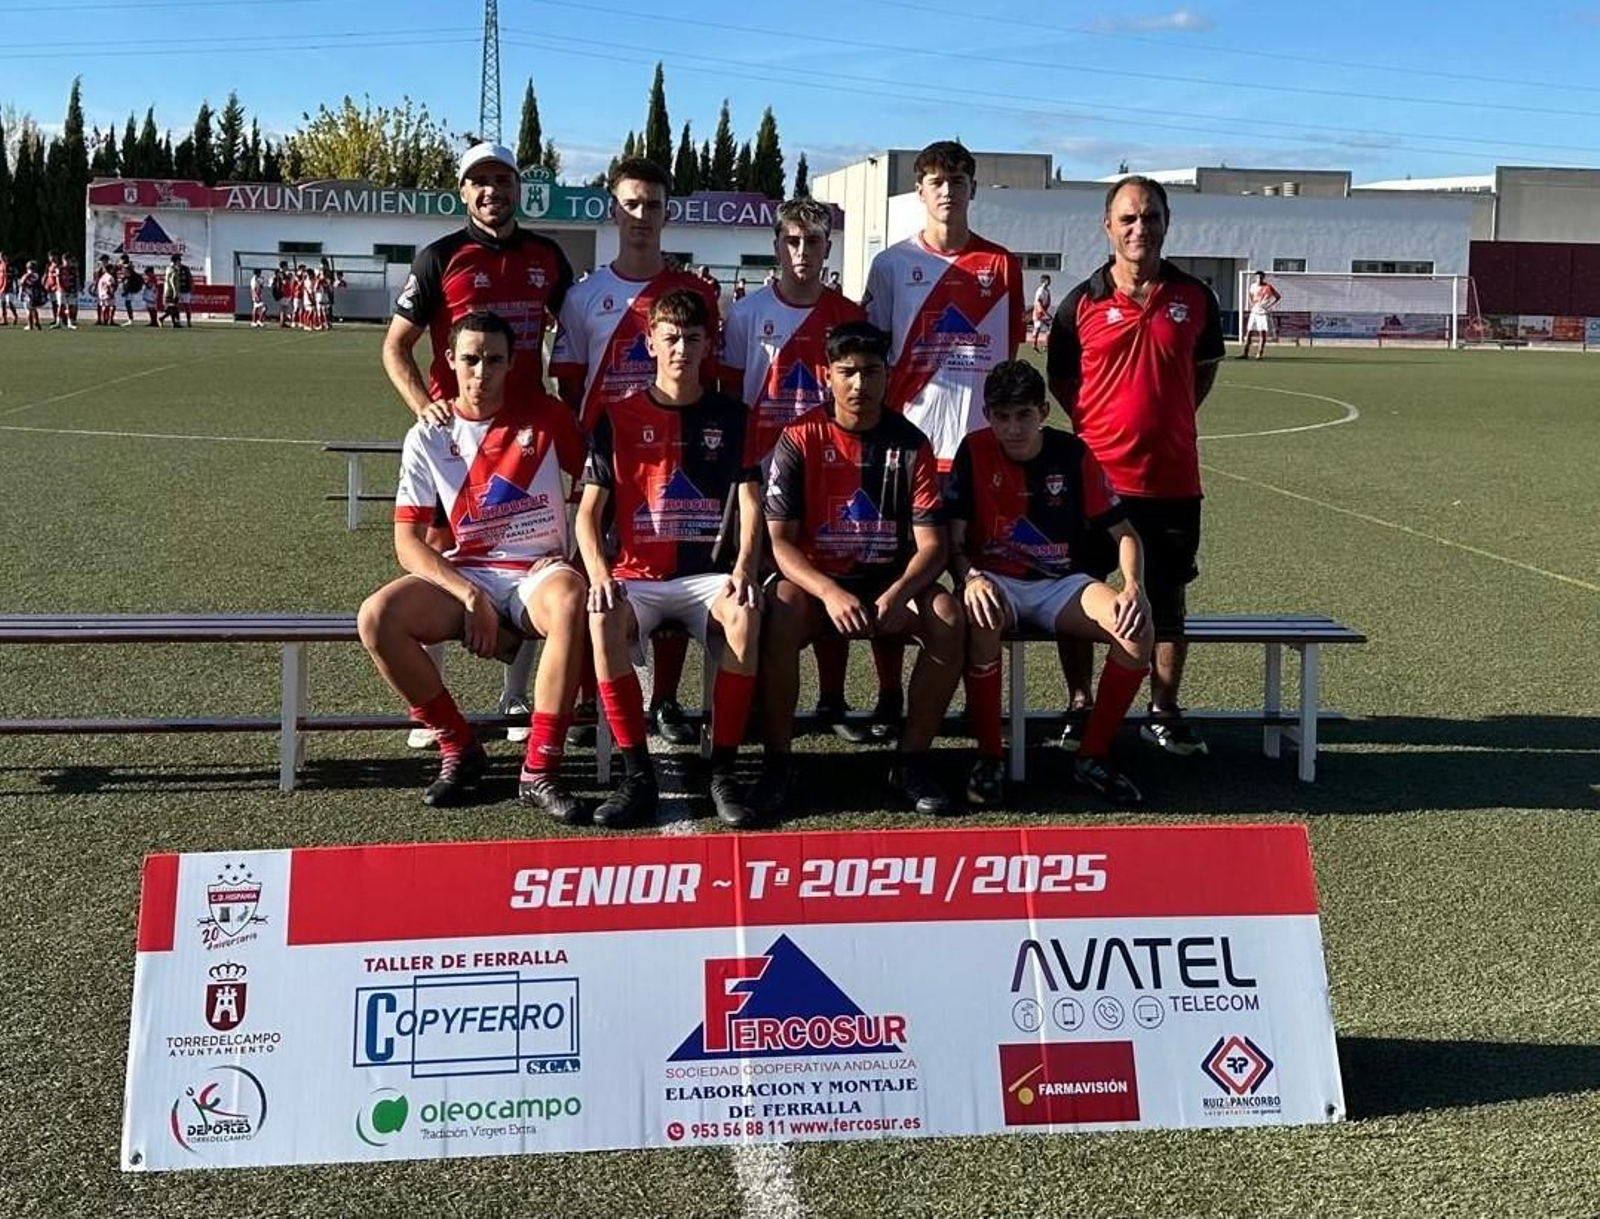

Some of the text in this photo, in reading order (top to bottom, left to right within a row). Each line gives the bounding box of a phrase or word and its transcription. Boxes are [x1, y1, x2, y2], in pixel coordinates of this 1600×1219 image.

[225, 186, 456, 215] AYUNTAMIENTO
[510, 864, 701, 908] SENIOR
[799, 857, 937, 897] 2024
[972, 854, 1107, 893] 2025
[364, 950, 568, 973] TALLER DE FERRALLA
[1010, 936, 1258, 992] AVATEL
[704, 956, 907, 1053] FERCOSUR
[1169, 994, 1260, 1012] TELECOM
[364, 992, 566, 1062] COPYFERRO
[166, 1032, 281, 1048] TORREDELCAMPO
[168, 1044, 275, 1057] AYUNTAMIENTO
[665, 1059, 917, 1079] SOCIEDAD COOPERATIVA ANDALUZA
[665, 1078, 918, 1101] ELABORACION Y MONTAJE
[1038, 1081, 1128, 1096] FARMAVISIÓN
[420, 1097, 582, 1123] oleocampo
[729, 1101, 862, 1118] DE FERRALLA
[470, 1125, 507, 1139] Virgen
[509, 1124, 536, 1134] Extra
[691, 1117, 921, 1139] 953 56 88 11 www.fercosur.es
